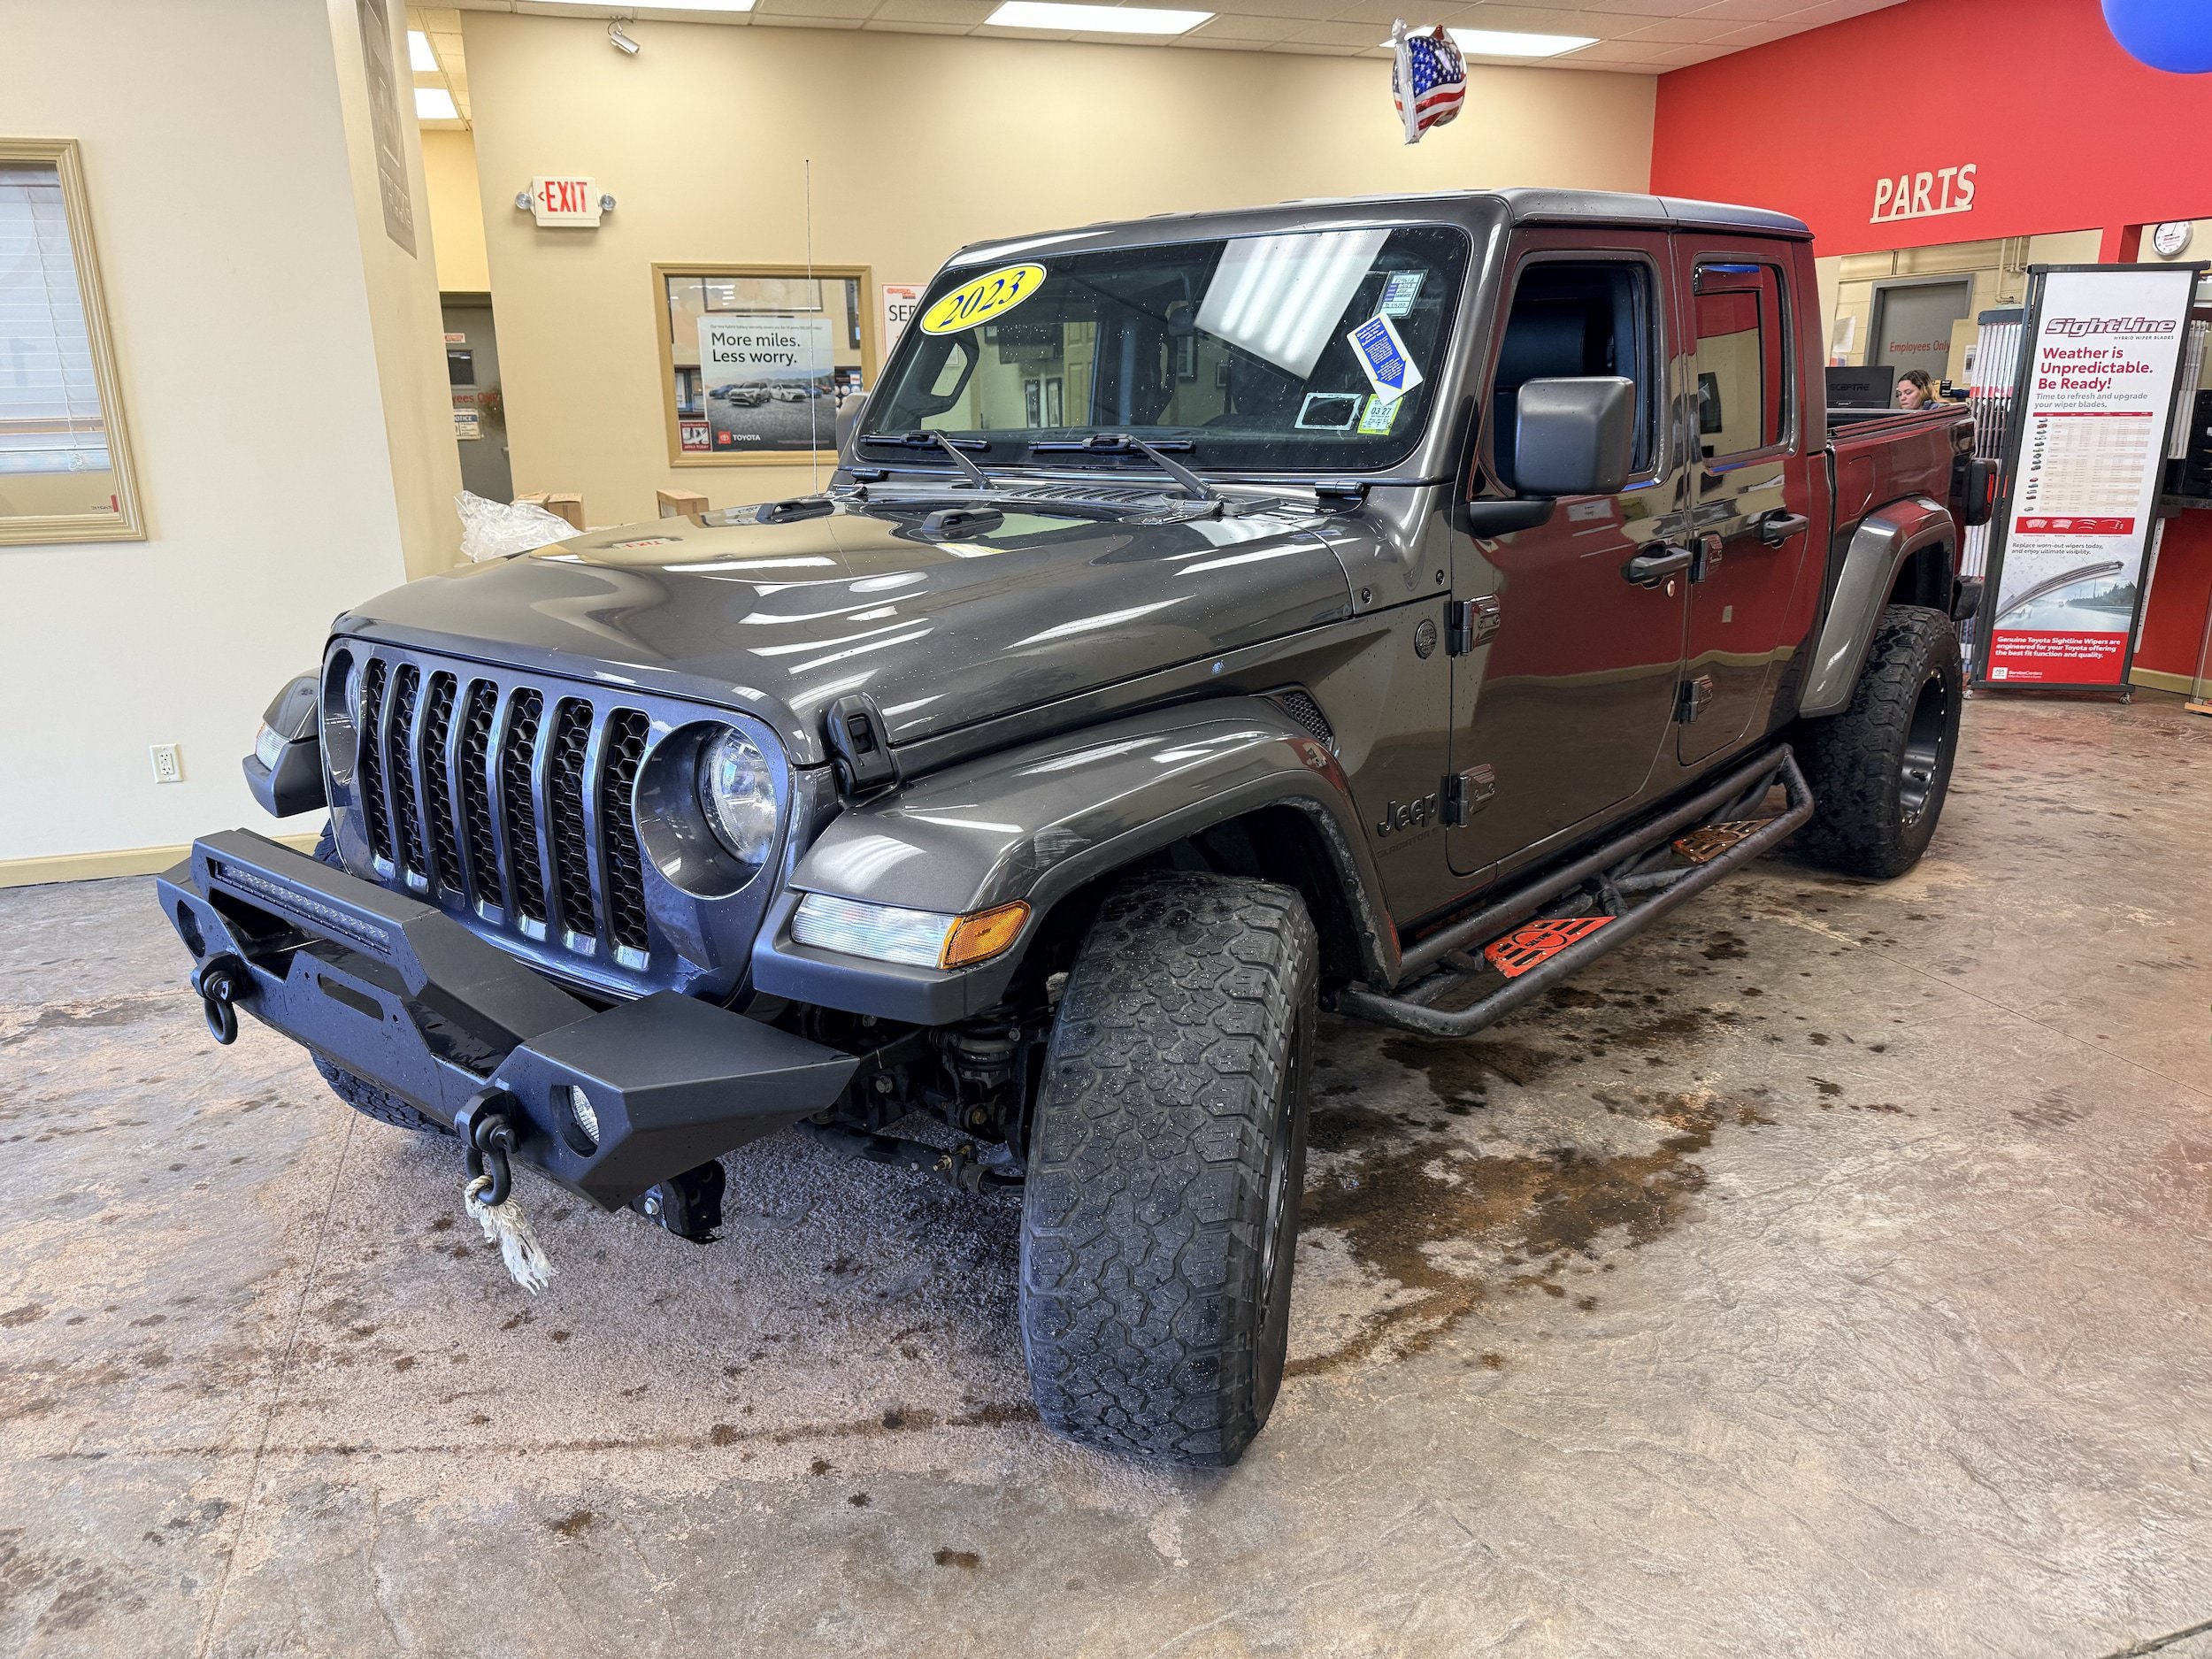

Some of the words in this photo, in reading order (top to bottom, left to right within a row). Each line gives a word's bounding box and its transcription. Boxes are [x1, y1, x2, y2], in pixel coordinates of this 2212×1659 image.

[544, 180, 588, 212] EXIT
[1870, 163, 1977, 220] PARTS
[938, 270, 1026, 328] 2023
[2045, 317, 2177, 338] SightLine
[711, 332, 752, 346] More
[757, 333, 801, 347] miles.
[1889, 341, 1931, 354] Employees
[1933, 340, 1951, 354] Only
[713, 349, 745, 362] Less
[749, 353, 797, 366] worry.
[2043, 346, 2108, 359] Weather
[2112, 346, 2124, 358] is
[2040, 361, 2153, 377] Unpredictable.
[2038, 378, 2057, 389] Be
[2061, 377, 2112, 392] Ready!
[2054, 401, 2076, 409] wiper
[2114, 393, 2148, 401] upgrade
[1377, 793, 1440, 837] Jeep
